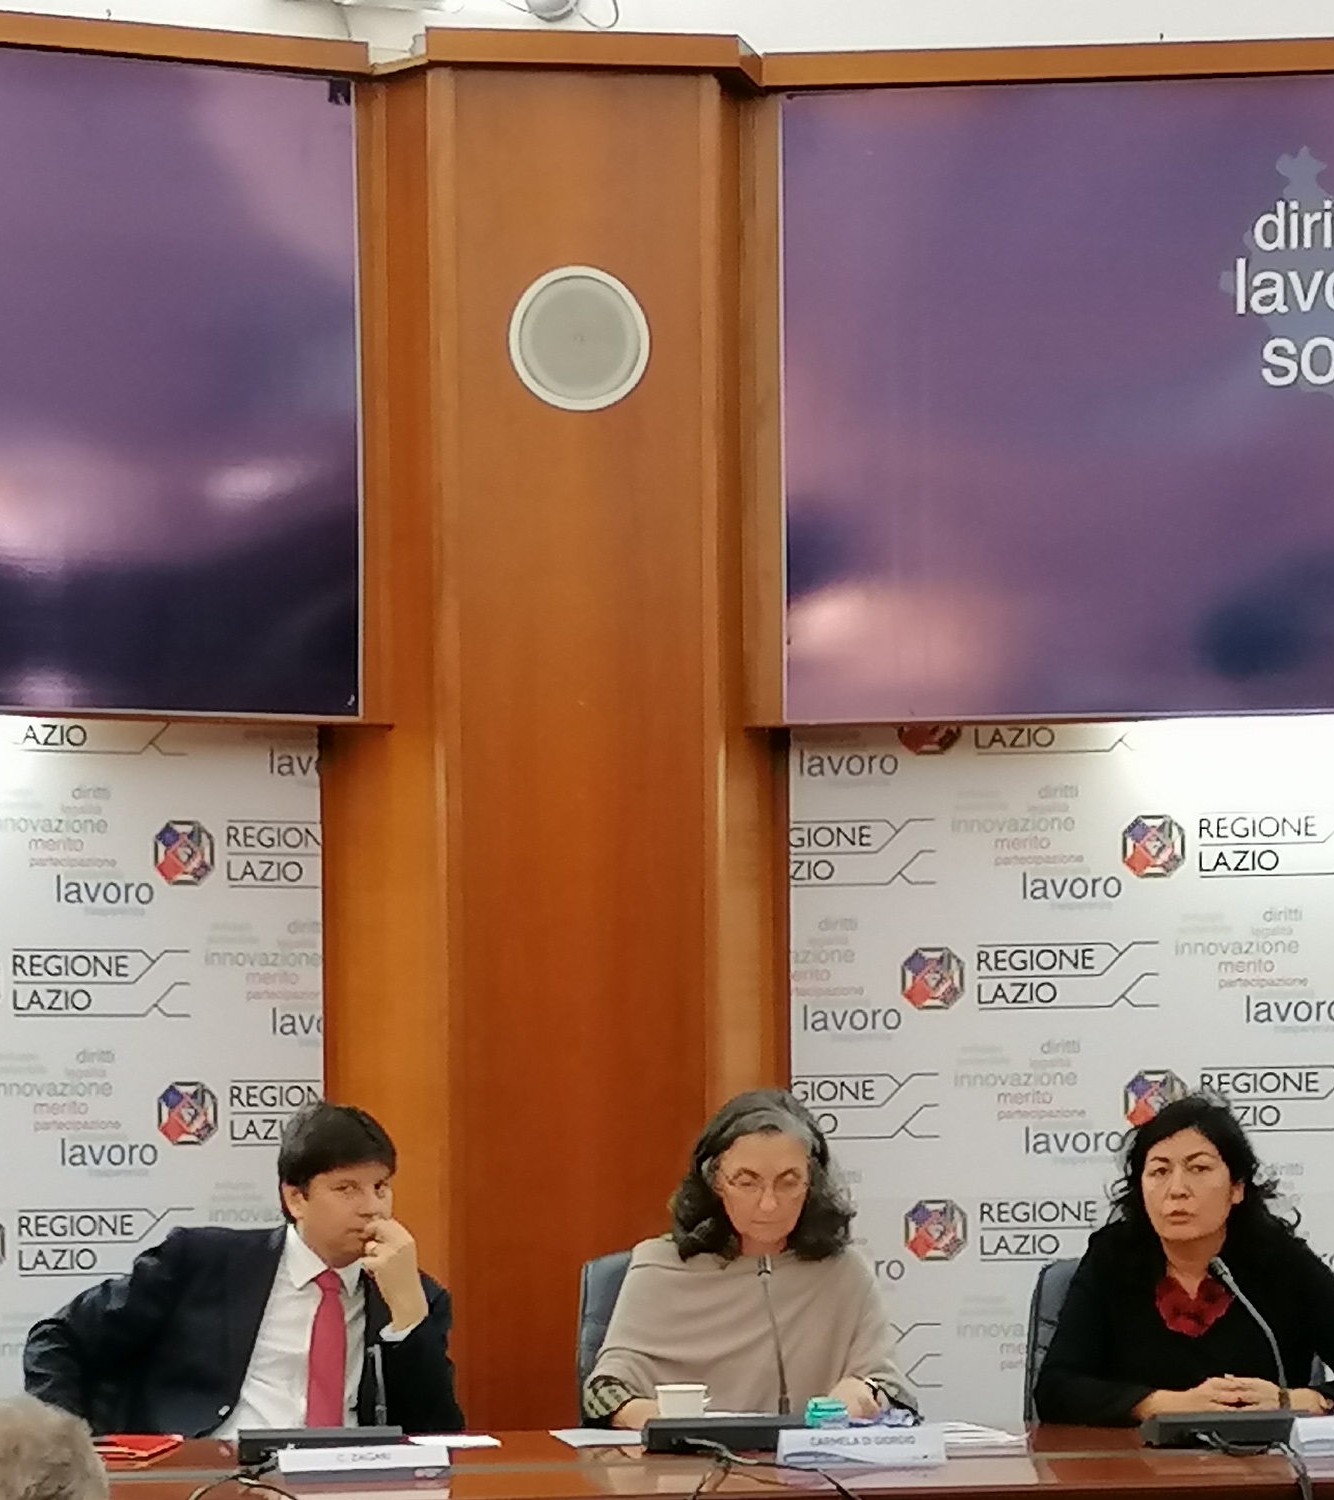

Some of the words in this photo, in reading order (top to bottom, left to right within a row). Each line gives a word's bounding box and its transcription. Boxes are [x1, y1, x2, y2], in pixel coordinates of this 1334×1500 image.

[974, 727, 1055, 749] LAZIO
[799, 750, 899, 777] lavoro
[951, 815, 1075, 833] innovazione
[1198, 815, 1318, 839] REGIONE
[226, 860, 304, 883] LAZIO
[1198, 849, 1280, 872] LAZIO
[55, 874, 155, 905] lavoro
[1021, 871, 1123, 900] lavoro
[1174, 937, 1299, 957] innovazione
[12, 955, 130, 978] REGIONE
[976, 949, 1095, 971] REGIONE
[12, 989, 93, 1012] LAZIO
[977, 982, 1058, 1005] LAZIO
[802, 1005, 902, 1031] lavoro
[954, 1070, 1077, 1087] innovazione
[1024, 1126, 1125, 1154] lavoro
[60, 1137, 159, 1168] lavoro
[979, 1201, 1097, 1223] REGIONE
[19, 1214, 134, 1237] REGIONE
[980, 1234, 1060, 1256] LAZIO
[19, 1248, 98, 1271] LAZIO
